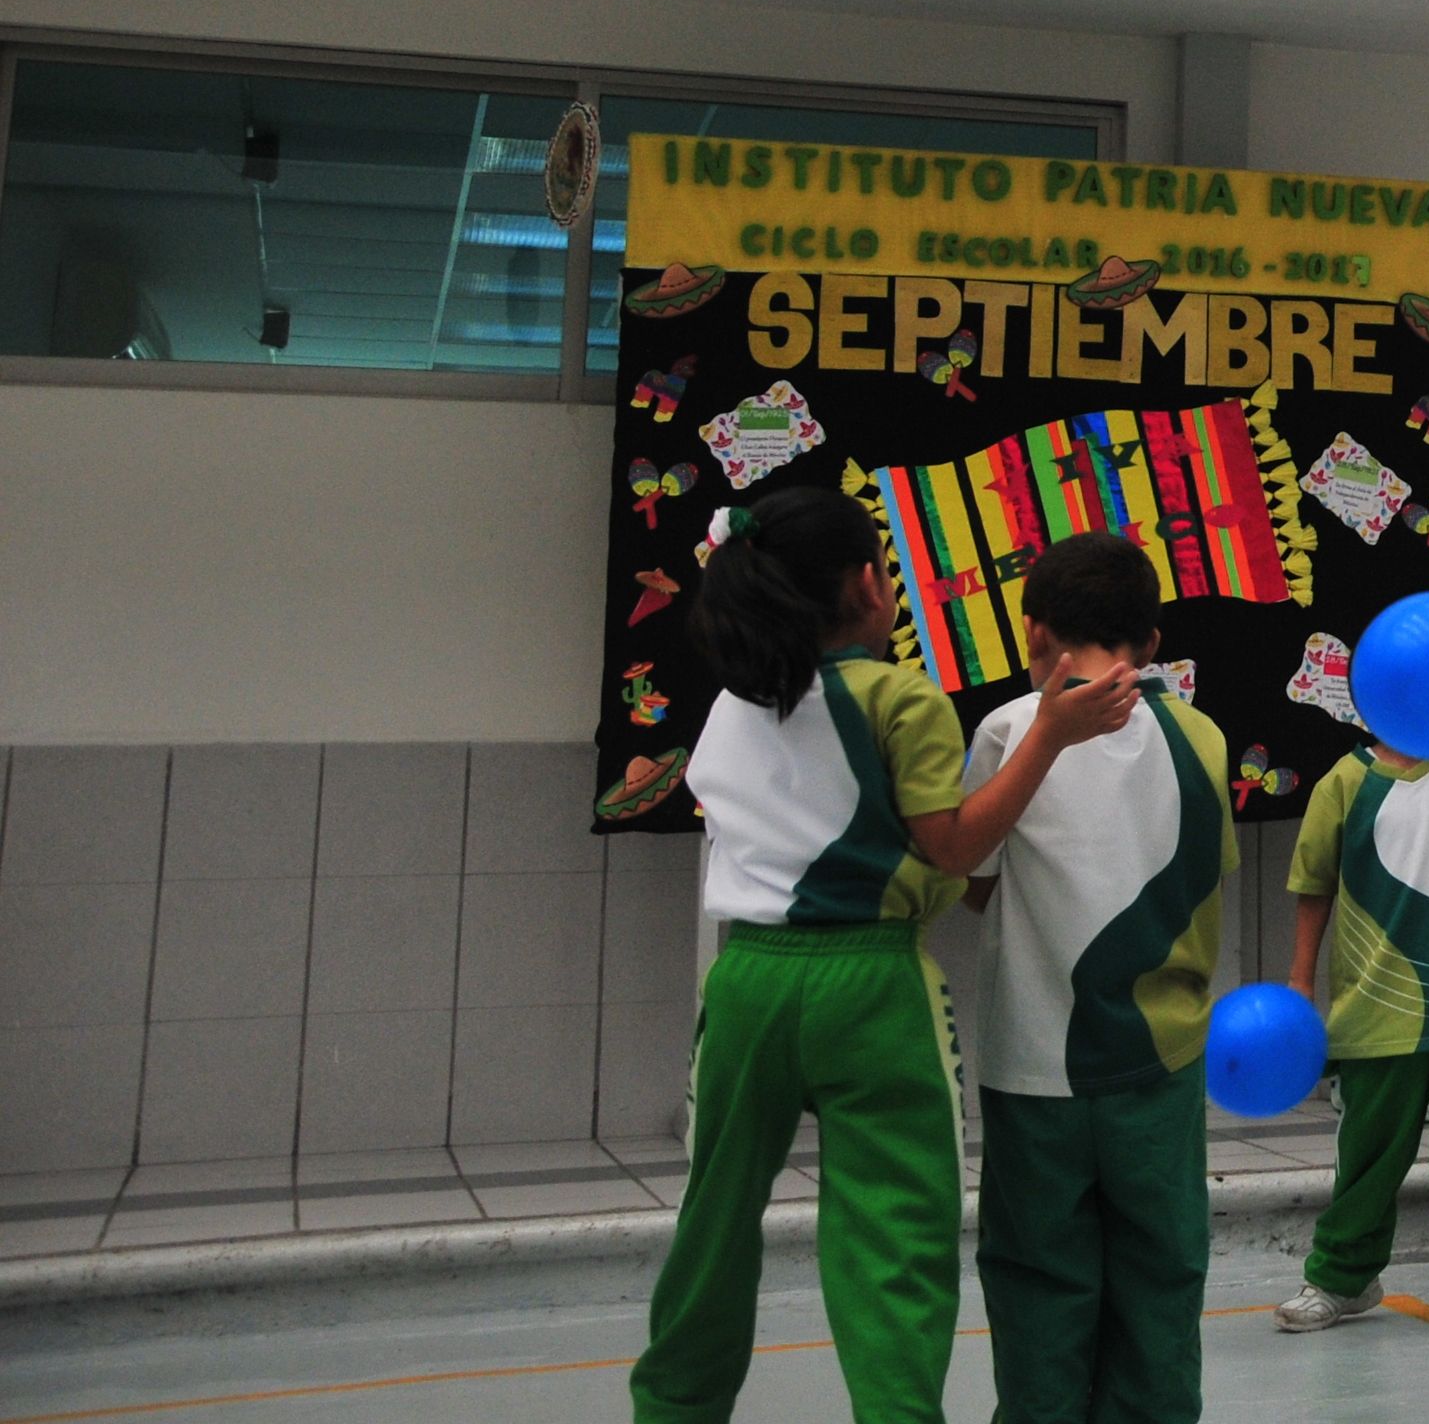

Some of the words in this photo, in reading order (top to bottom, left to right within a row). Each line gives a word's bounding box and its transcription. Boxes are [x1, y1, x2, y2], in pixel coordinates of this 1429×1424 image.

[664, 141, 1012, 203] INSTITUTO
[1043, 159, 1238, 217] PATRIA
[739, 222, 879, 261] CICLO
[916, 229, 1100, 270] ESCOLAR
[1160, 243, 1251, 282] 2016
[747, 272, 1395, 394] SEPTIEMBRE
[925, 503, 1249, 607] MEICO
